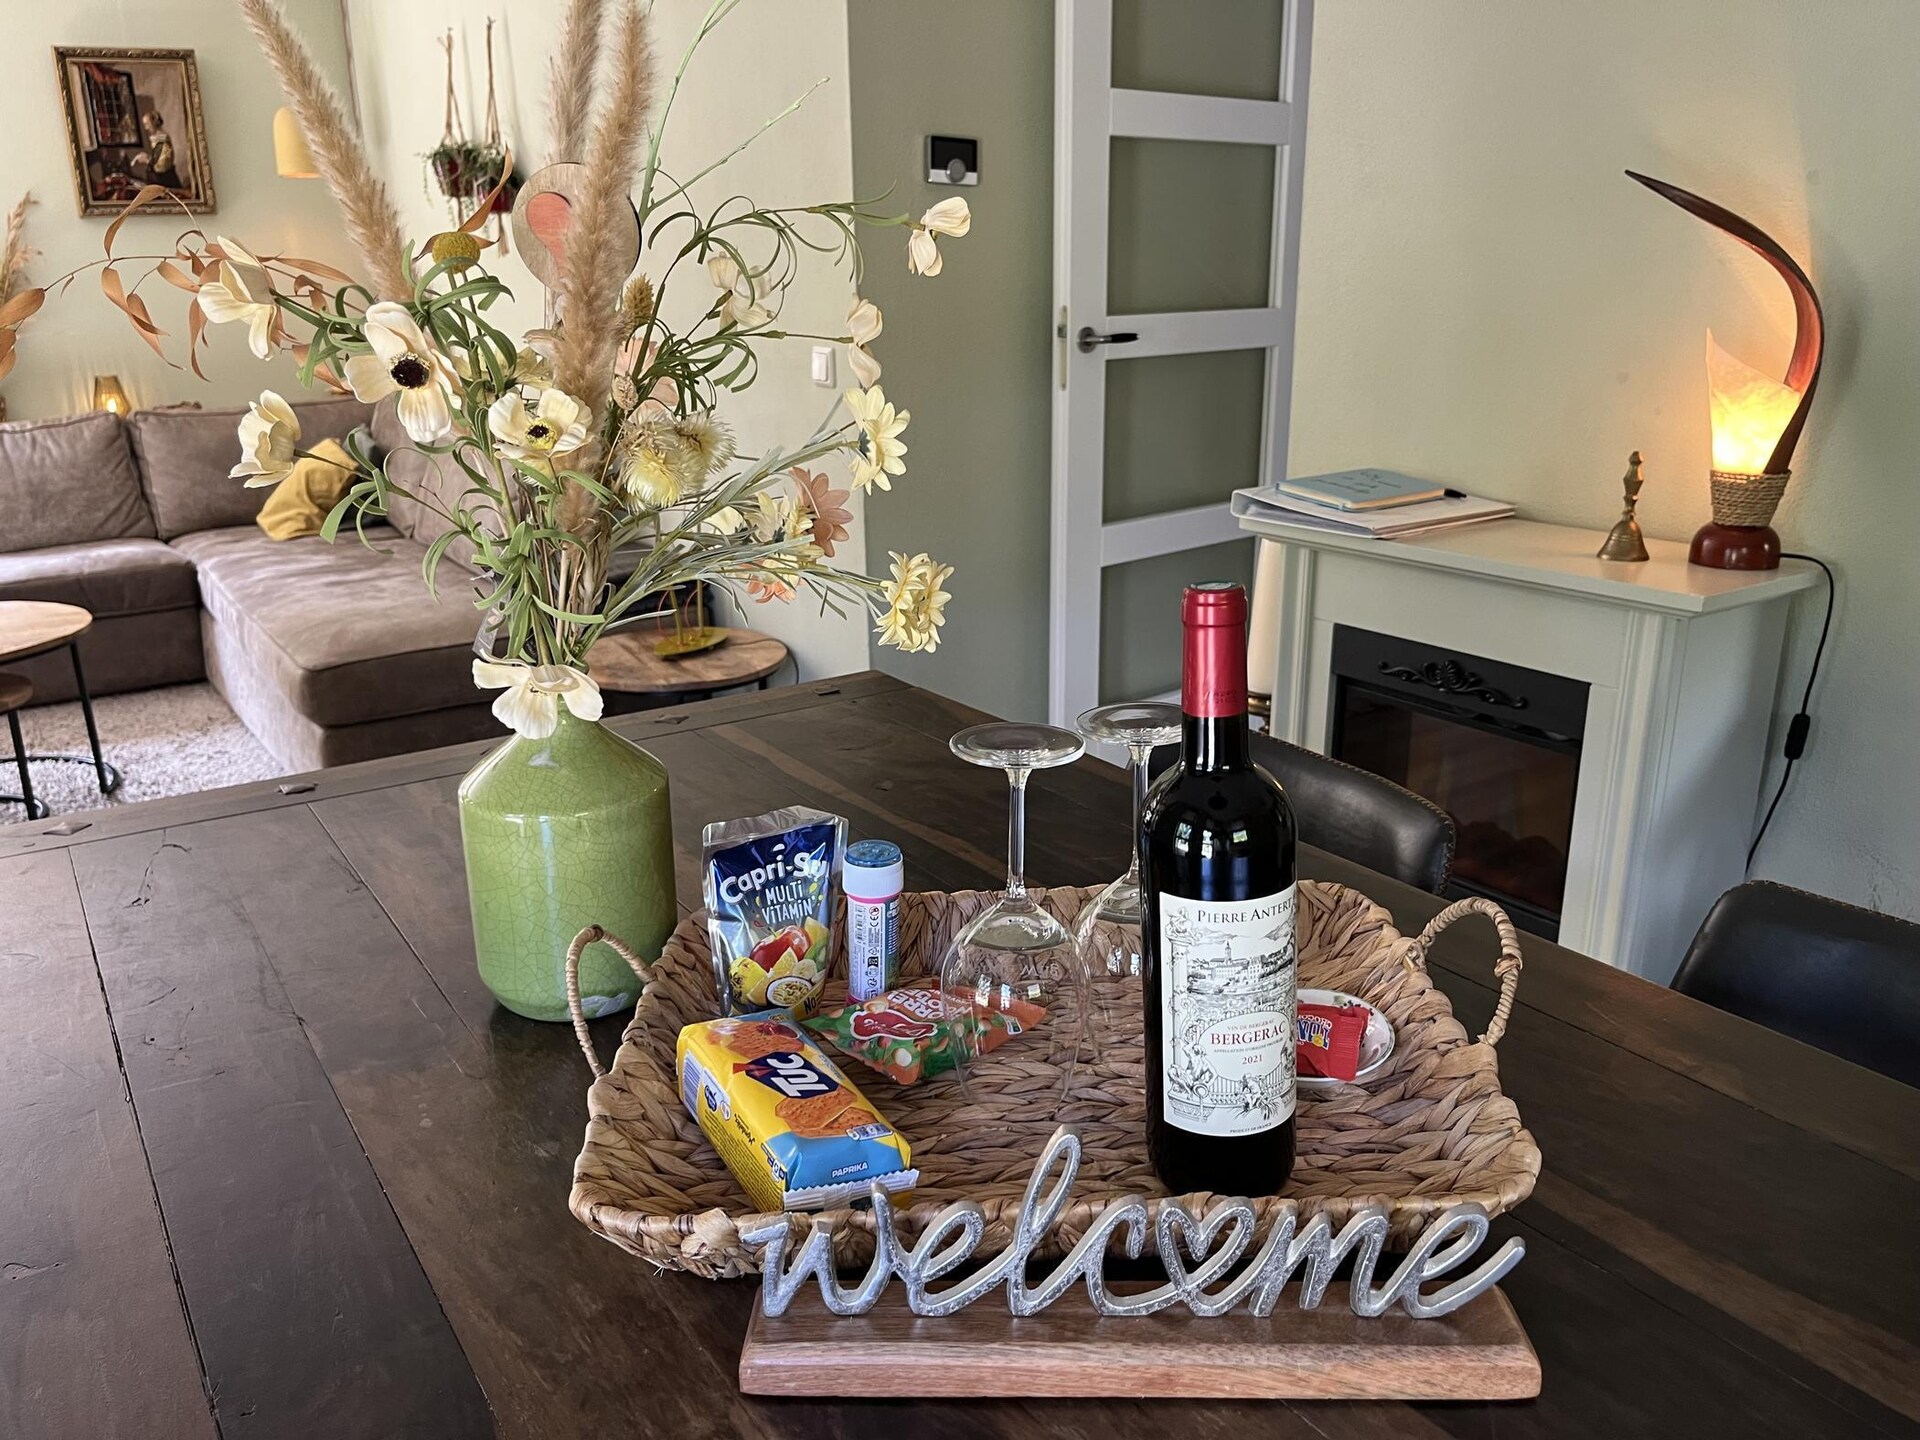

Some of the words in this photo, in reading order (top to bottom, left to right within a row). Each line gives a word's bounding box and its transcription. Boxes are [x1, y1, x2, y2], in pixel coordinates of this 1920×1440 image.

[1211, 1020, 1286, 1045] BERGERAC
[1242, 1054, 1262, 1065] 2021
[766, 1053, 829, 1097] TUC
[832, 1161, 868, 1178] PAPRIKA
[740, 1124, 1526, 1319] welcome
